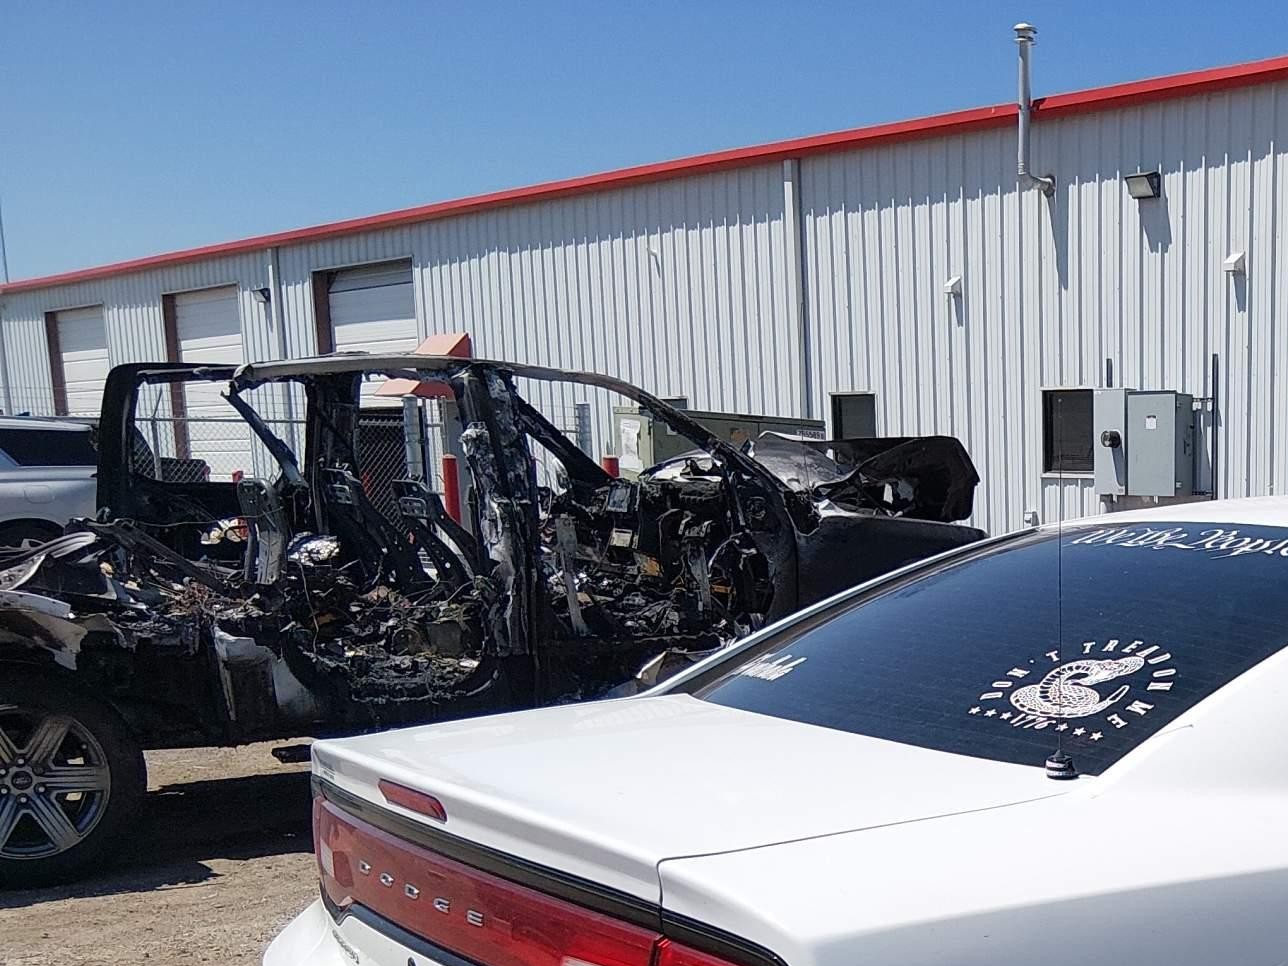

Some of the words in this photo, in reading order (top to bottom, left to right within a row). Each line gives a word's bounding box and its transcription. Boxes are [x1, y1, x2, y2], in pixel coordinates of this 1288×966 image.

[1082, 639, 1172, 664] TREAD
[1146, 667, 1178, 692] ON
[1009, 713, 1058, 730] 1776
[1106, 700, 1155, 729] ME
[359, 859, 485, 927] DODGE
